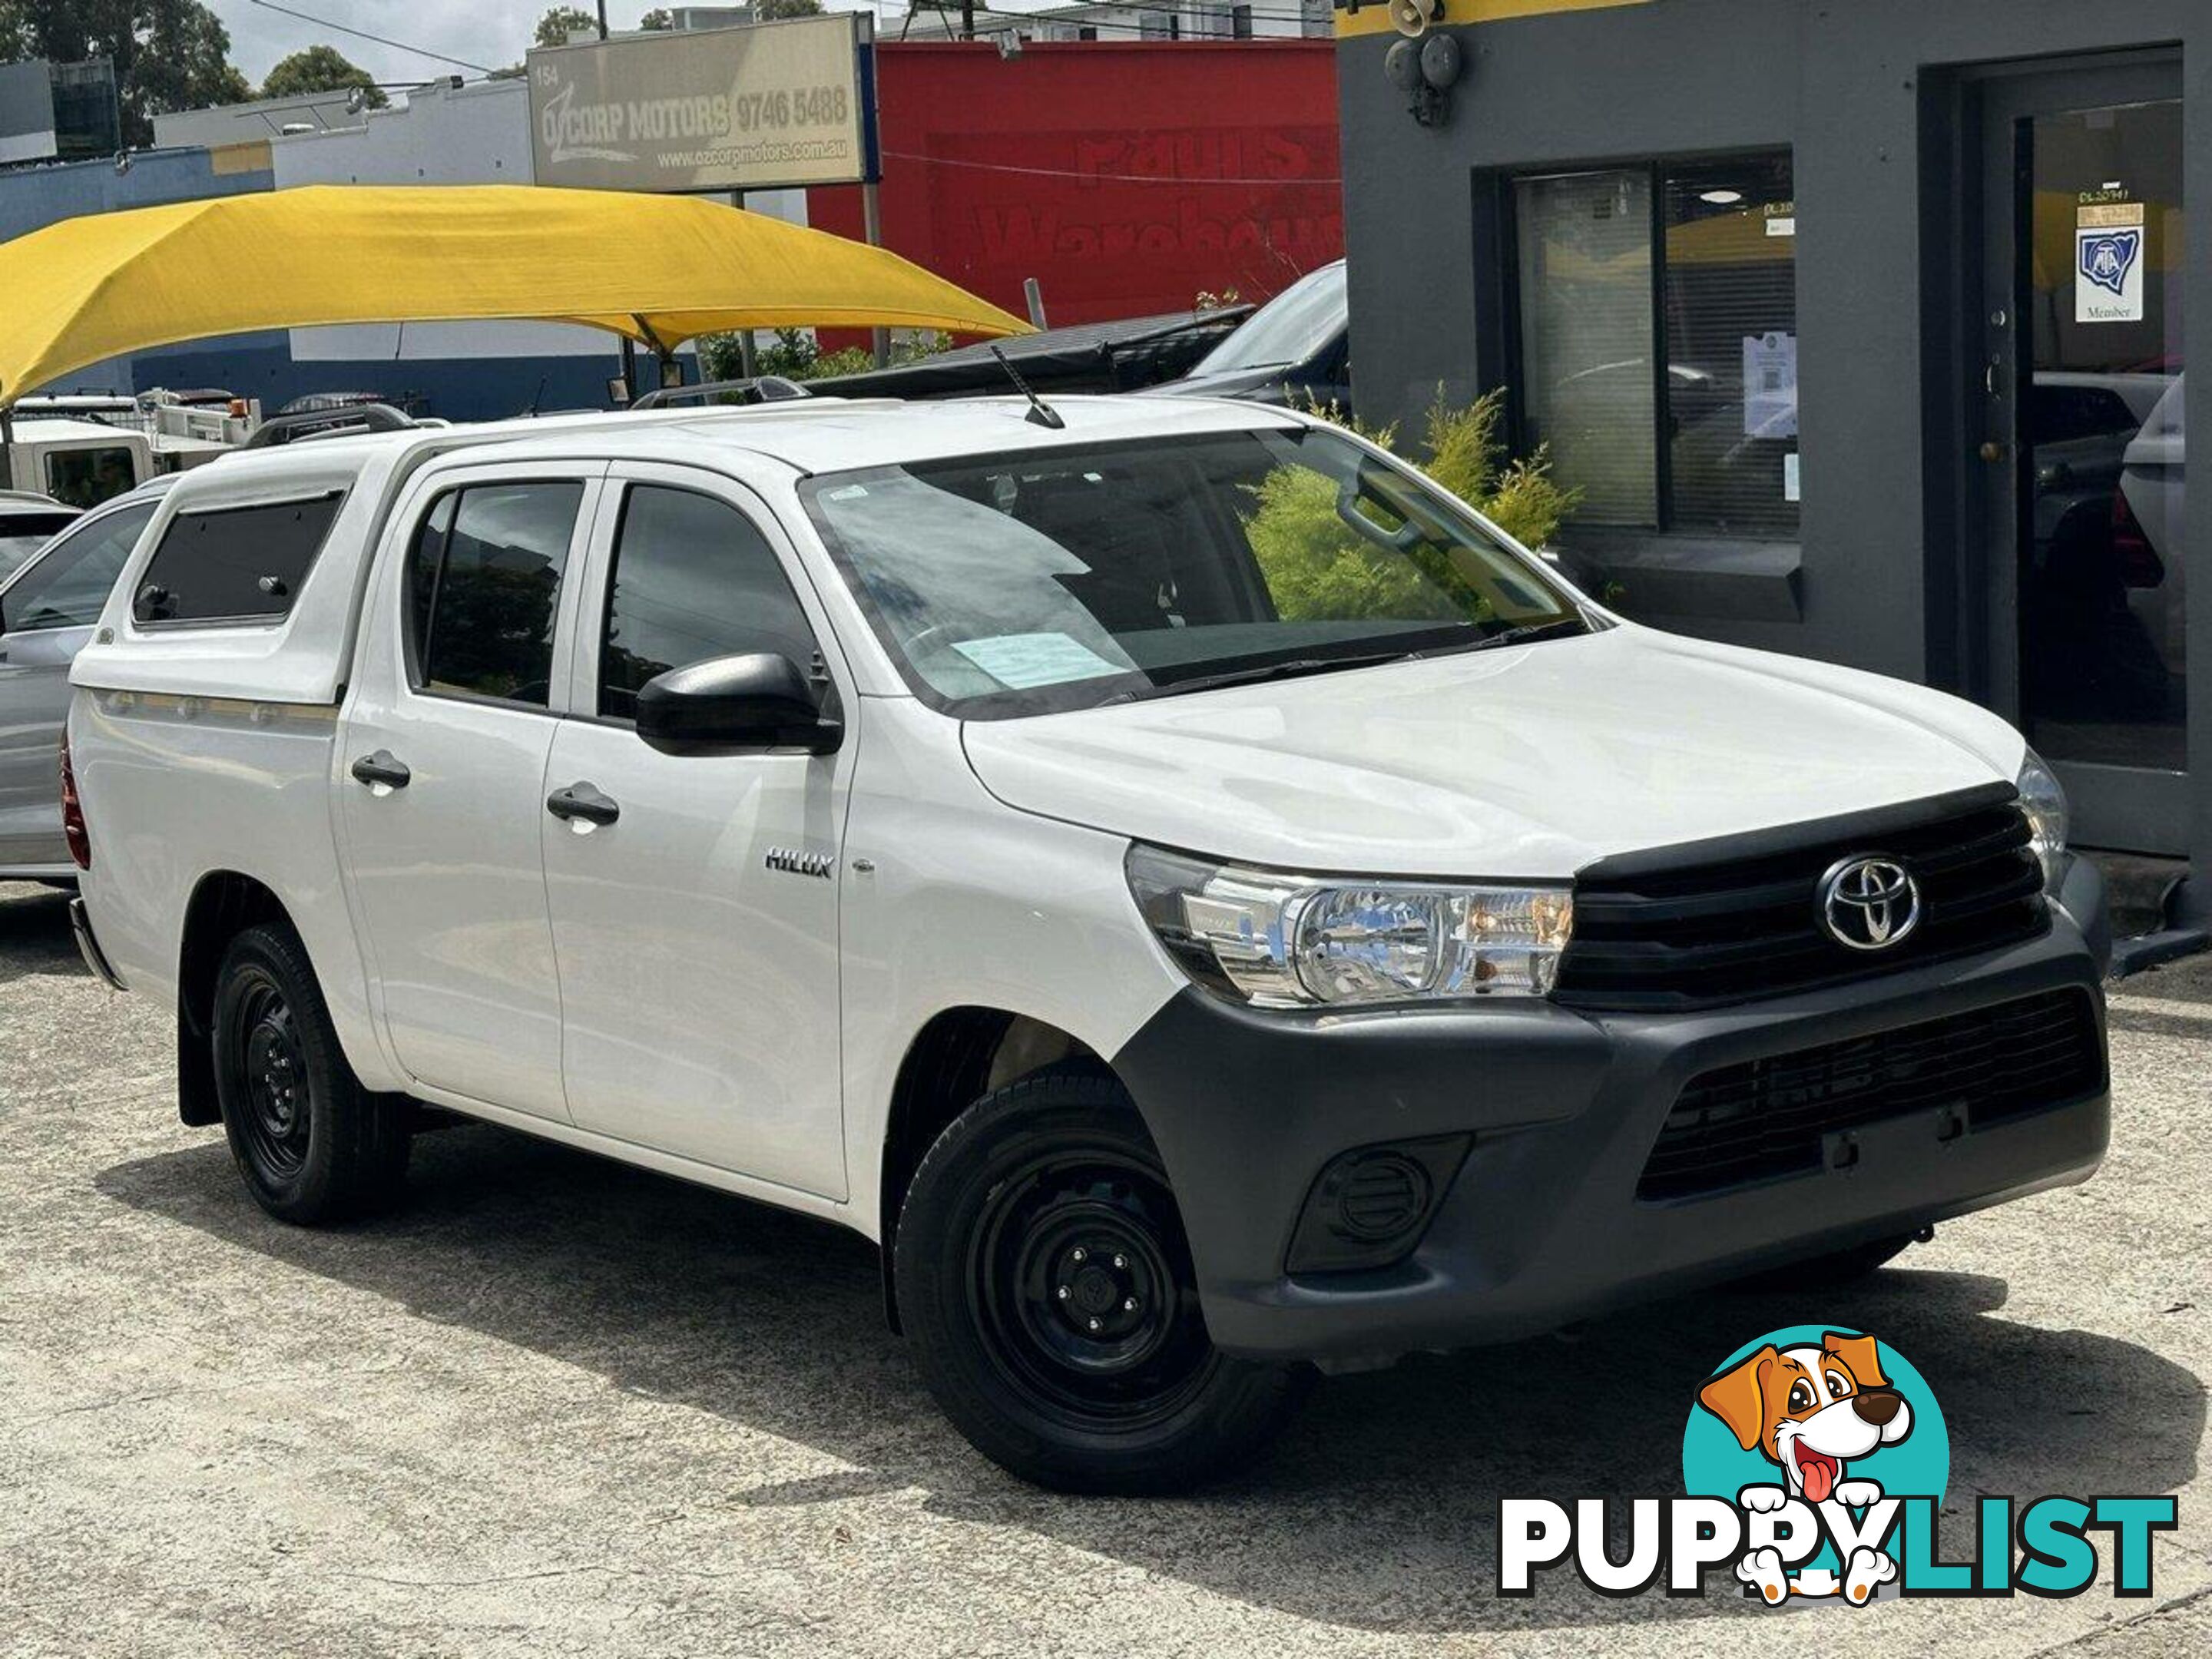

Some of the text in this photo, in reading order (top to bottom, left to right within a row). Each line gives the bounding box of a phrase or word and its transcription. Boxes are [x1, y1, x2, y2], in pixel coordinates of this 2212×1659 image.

[628, 94, 730, 141] MOTORS
[737, 91, 790, 131] 9746
[793, 84, 848, 126] 5488
[657, 139, 847, 170] www.ozcorpmotors.com.au
[2088, 306, 2131, 319] Member
[765, 847, 835, 879] HILUX
